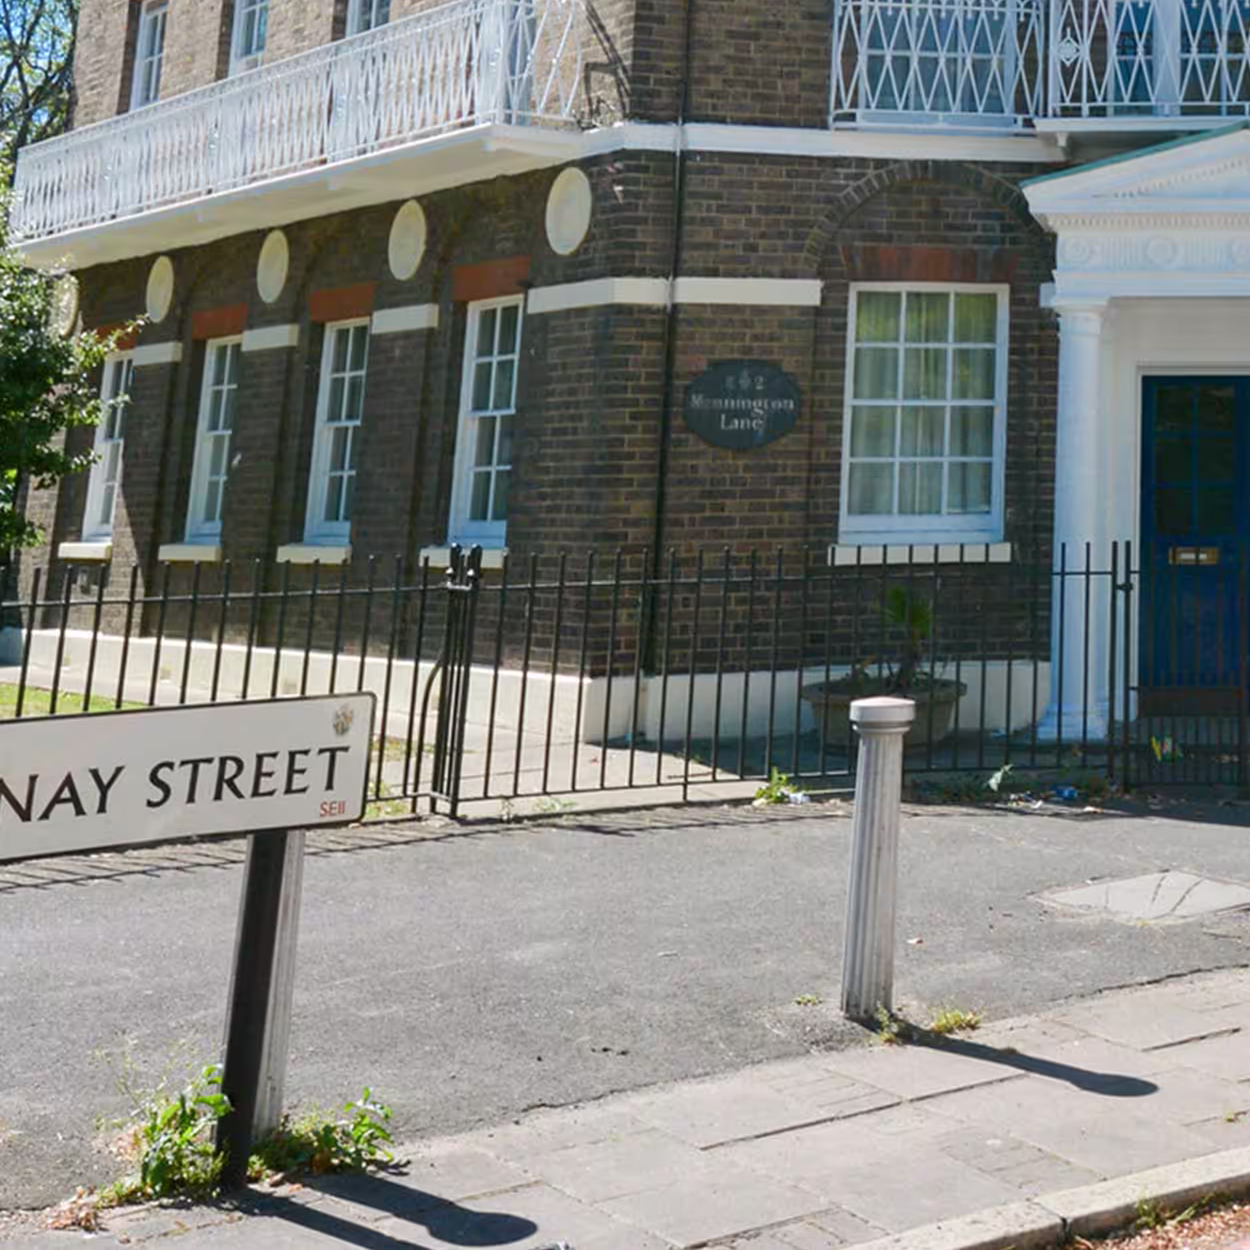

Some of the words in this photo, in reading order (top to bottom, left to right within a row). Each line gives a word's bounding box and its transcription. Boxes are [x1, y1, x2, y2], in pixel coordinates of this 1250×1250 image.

[690, 393, 795, 417] Kennington
[720, 413, 764, 430] Lane
[146, 746, 350, 808] STREET
